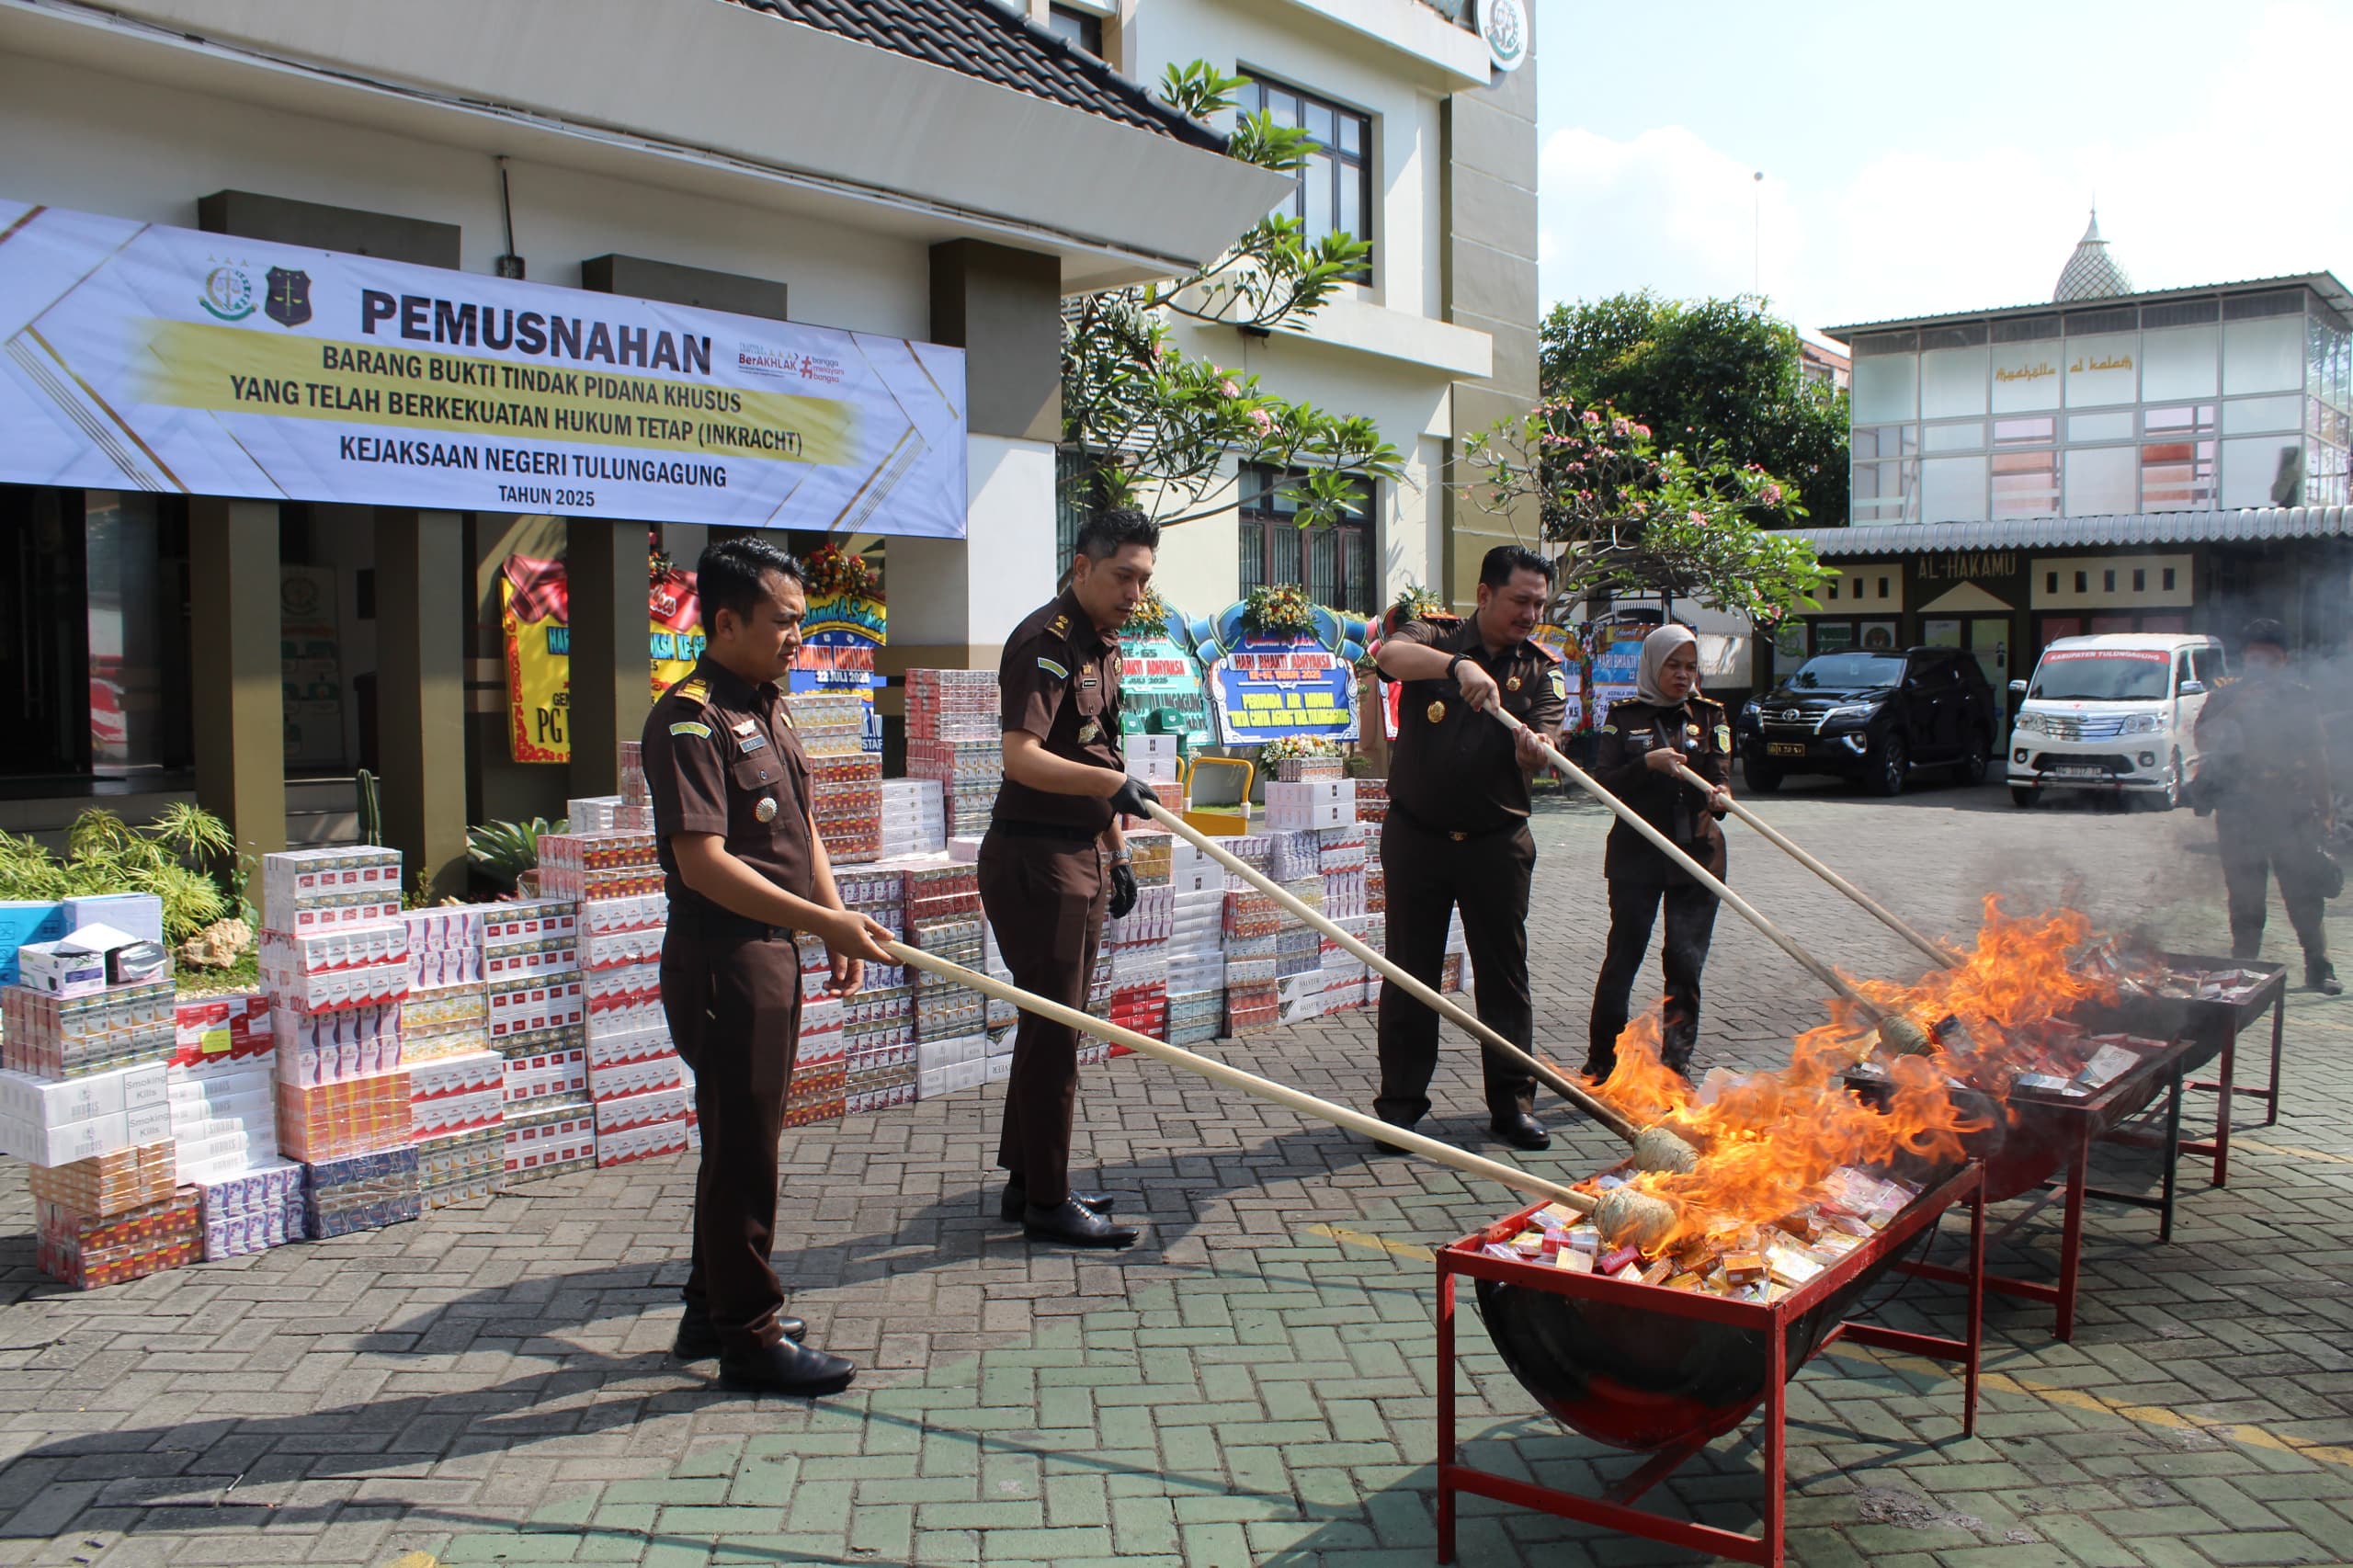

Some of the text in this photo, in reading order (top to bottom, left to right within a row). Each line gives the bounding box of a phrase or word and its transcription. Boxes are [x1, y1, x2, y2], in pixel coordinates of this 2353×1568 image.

[360, 288, 712, 376] PEMUSNAHAN
[738, 352, 798, 371] BerAKHLAK
[812, 356, 839, 368] bangga
[323, 345, 742, 414] BARANG BUKTI TINDAK PIDANA KHUSUS
[231, 374, 802, 457] YANG TELAH BERKEKUATAN HUKUM TETAP (INKRACHT)
[339, 435, 727, 487] KEJAKSAAN NEGERI TULUNGAGUNG
[497, 484, 596, 507] TAHUN 2025
[1917, 552, 2017, 579] AL-HAKAMU
[1234, 653, 1332, 670] HARI BHAKTI ADHYAKSA
[1597, 653, 1637, 669] HARI BHAKTI
[2050, 651, 2161, 661] KABUPATEN TULUNGAGUNG
[816, 670, 870, 684] 22 JULI 2025
[1301, 669, 1323, 681] 2025
[125, 1074, 167, 1090] Smoking
[136, 1088, 158, 1100] Kills
[129, 1110, 169, 1129] Smoking
[139, 1126, 160, 1139] Kills
